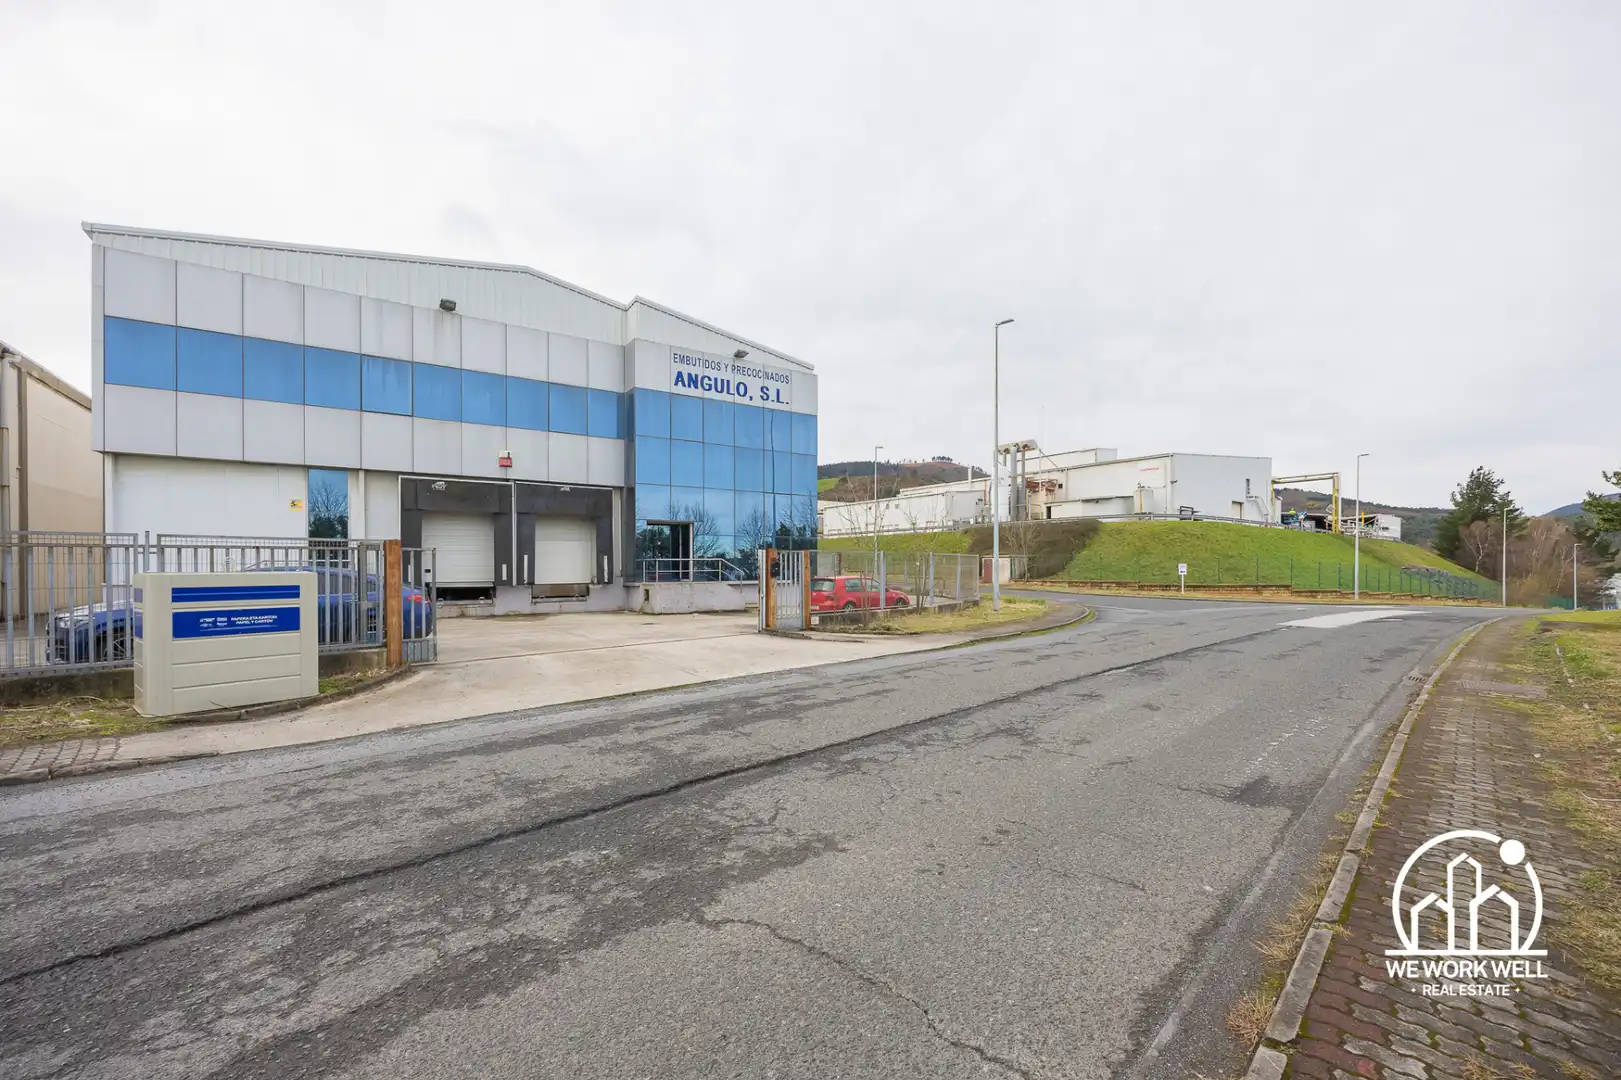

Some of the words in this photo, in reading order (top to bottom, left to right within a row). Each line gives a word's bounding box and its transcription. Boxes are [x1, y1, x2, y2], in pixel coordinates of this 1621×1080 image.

[673, 353, 721, 371] EMBUTIDOS
[724, 363, 729, 373] Y
[731, 364, 790, 384] PRECOCINADOS
[674, 370, 753, 401] ANGULO,
[760, 385, 790, 405] S.L.
